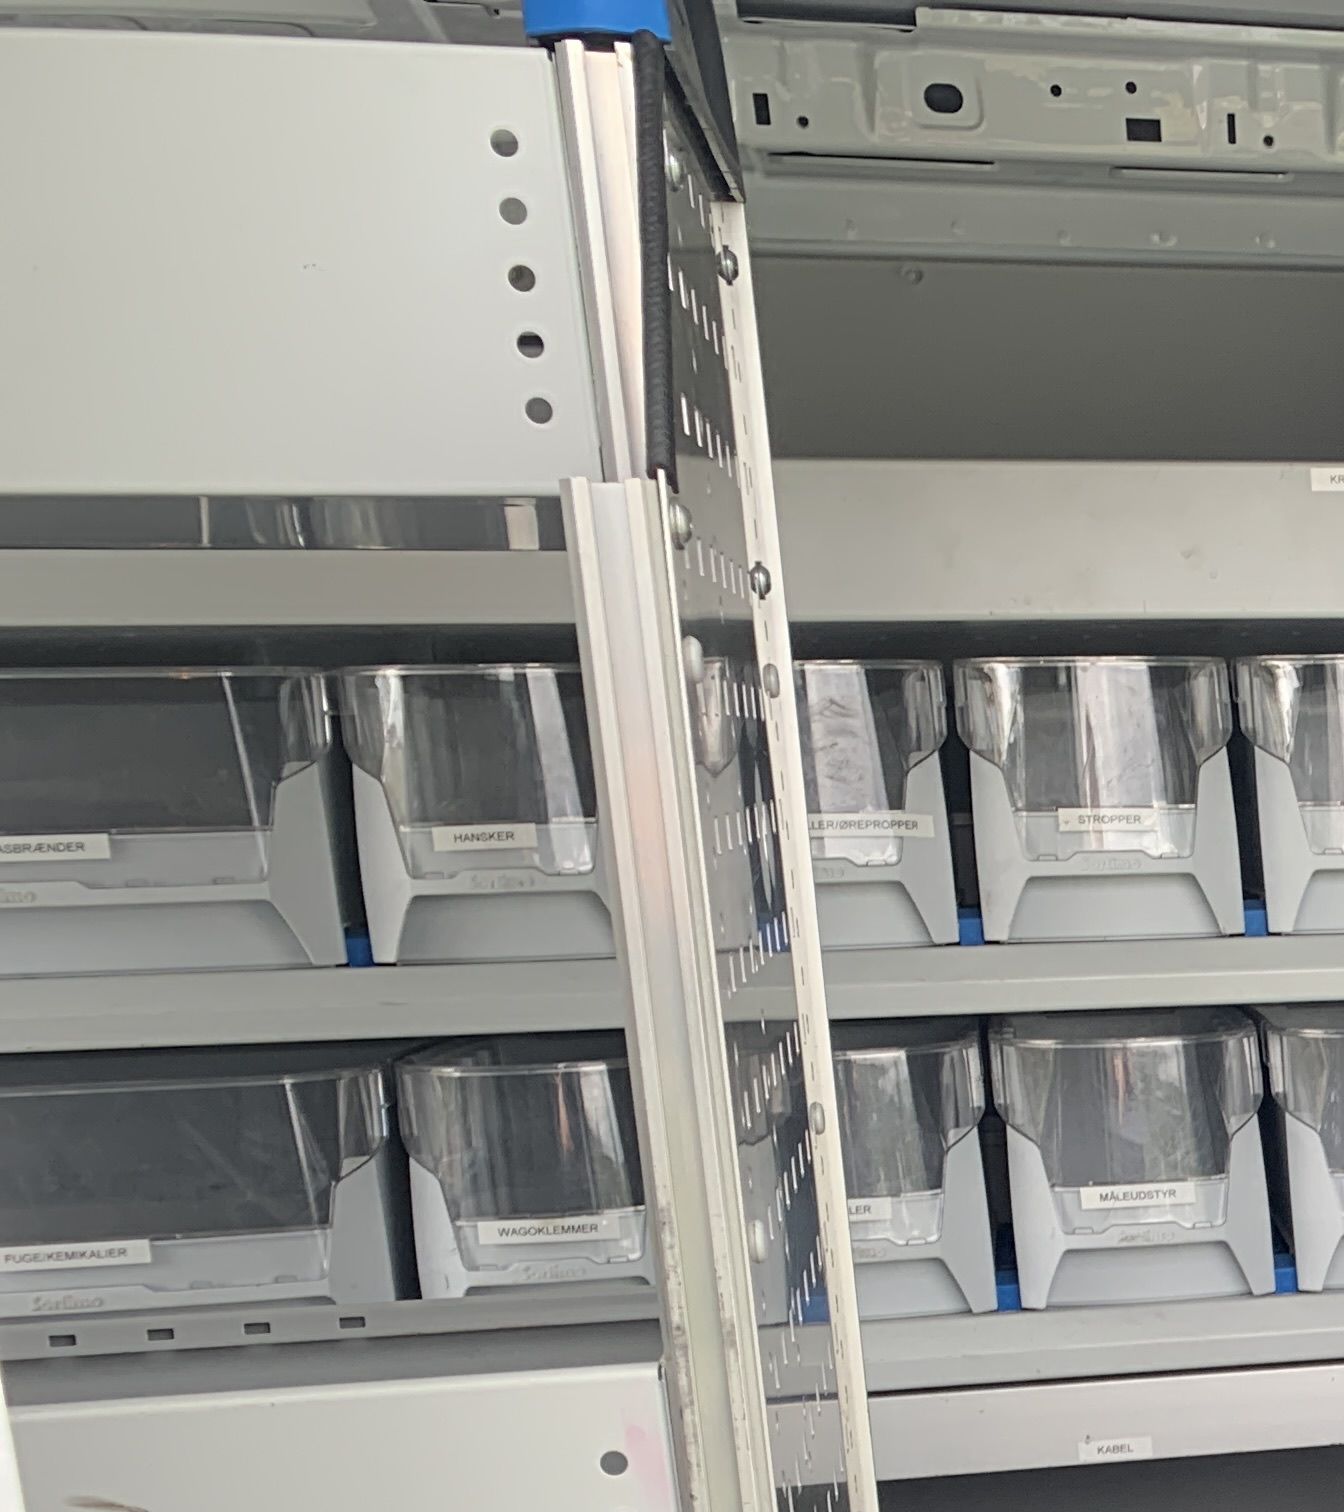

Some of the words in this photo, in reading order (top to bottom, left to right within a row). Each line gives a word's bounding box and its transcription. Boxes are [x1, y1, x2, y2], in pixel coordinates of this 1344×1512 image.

[808, 819, 919, 831] LER/ØREPROPPER
[1078, 814, 1142, 825] STROPPER
[453, 831, 515, 843] HANSKER
[1099, 1189, 1177, 1203] MÅLEUDSTYR
[497, 1223, 599, 1237] WAGOKLEMMER
[4, 1247, 128, 1264] FUGE/KEMIKALIER
[1097, 1443, 1134, 1455] KABEL
